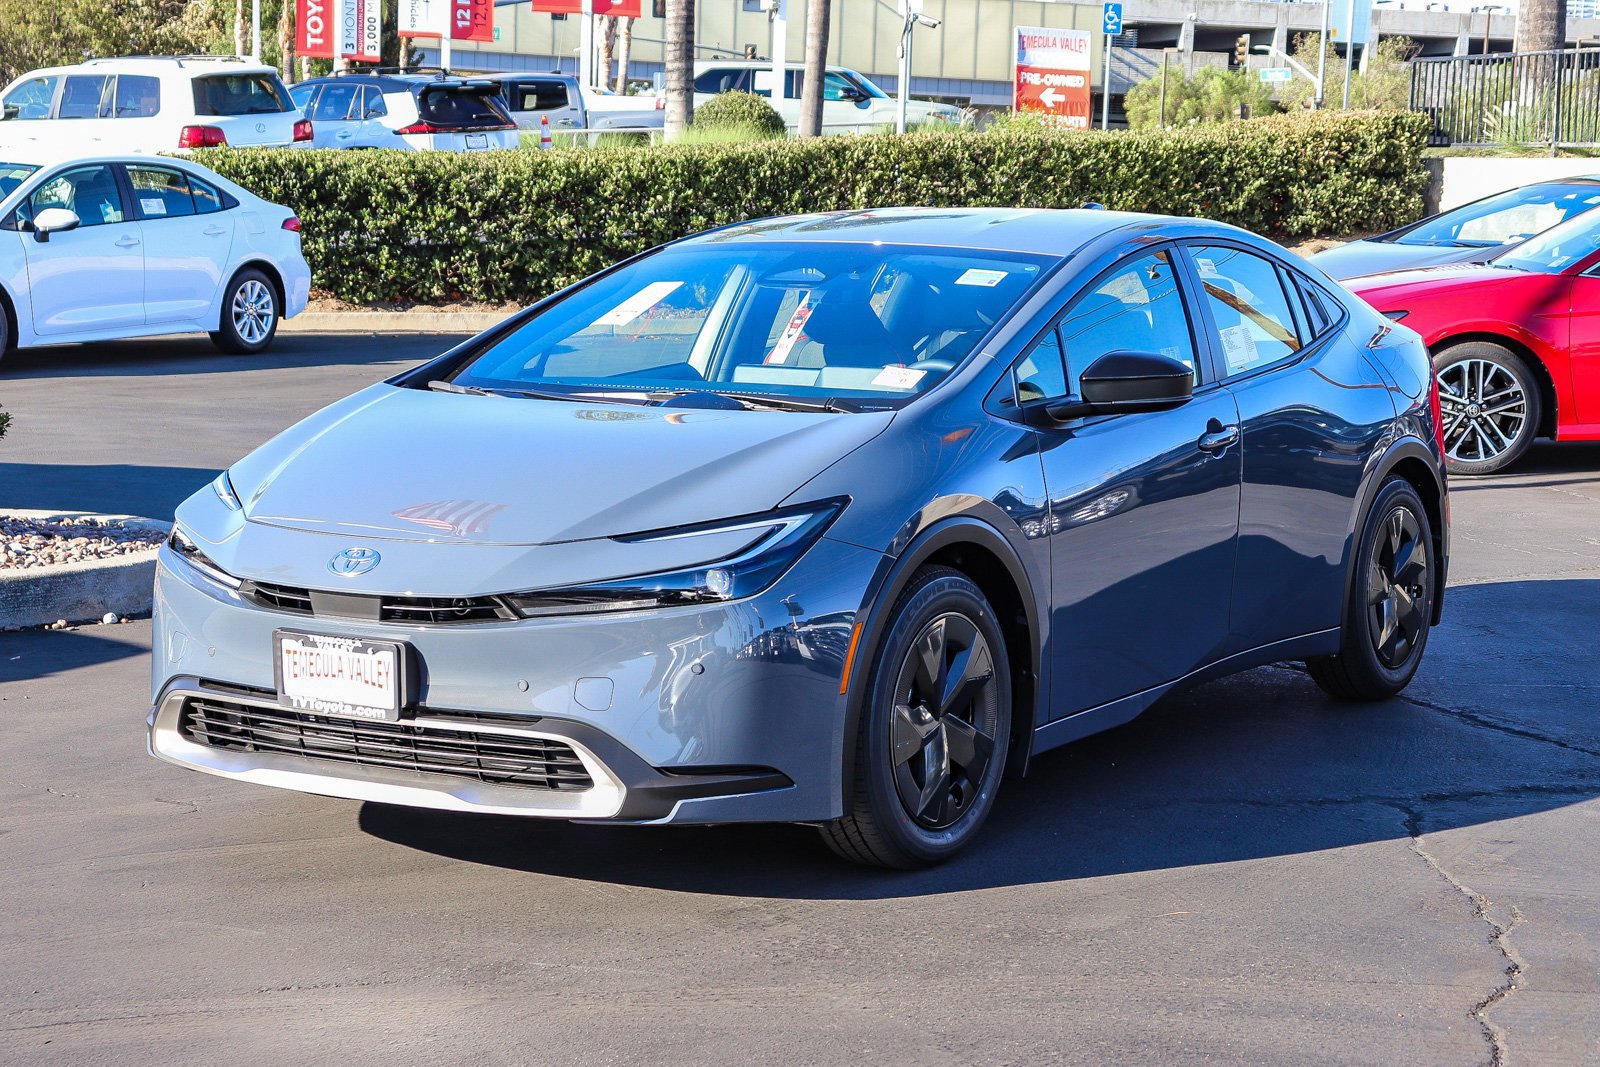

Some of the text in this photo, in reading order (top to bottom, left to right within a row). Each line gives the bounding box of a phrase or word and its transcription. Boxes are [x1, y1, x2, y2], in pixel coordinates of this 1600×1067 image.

[306, 0, 324, 49] TOY
[456, 8, 471, 28] 12
[367, 16, 378, 51] 3,000
[1019, 34, 1088, 53] TEMECULA VALLEY
[345, 42, 355, 50] 3
[1020, 72, 1085, 88] PRE-OWNED
[286, 650, 390, 690] TEMECULA VALLEY
[291, 696, 385, 719] TVToyota.com
